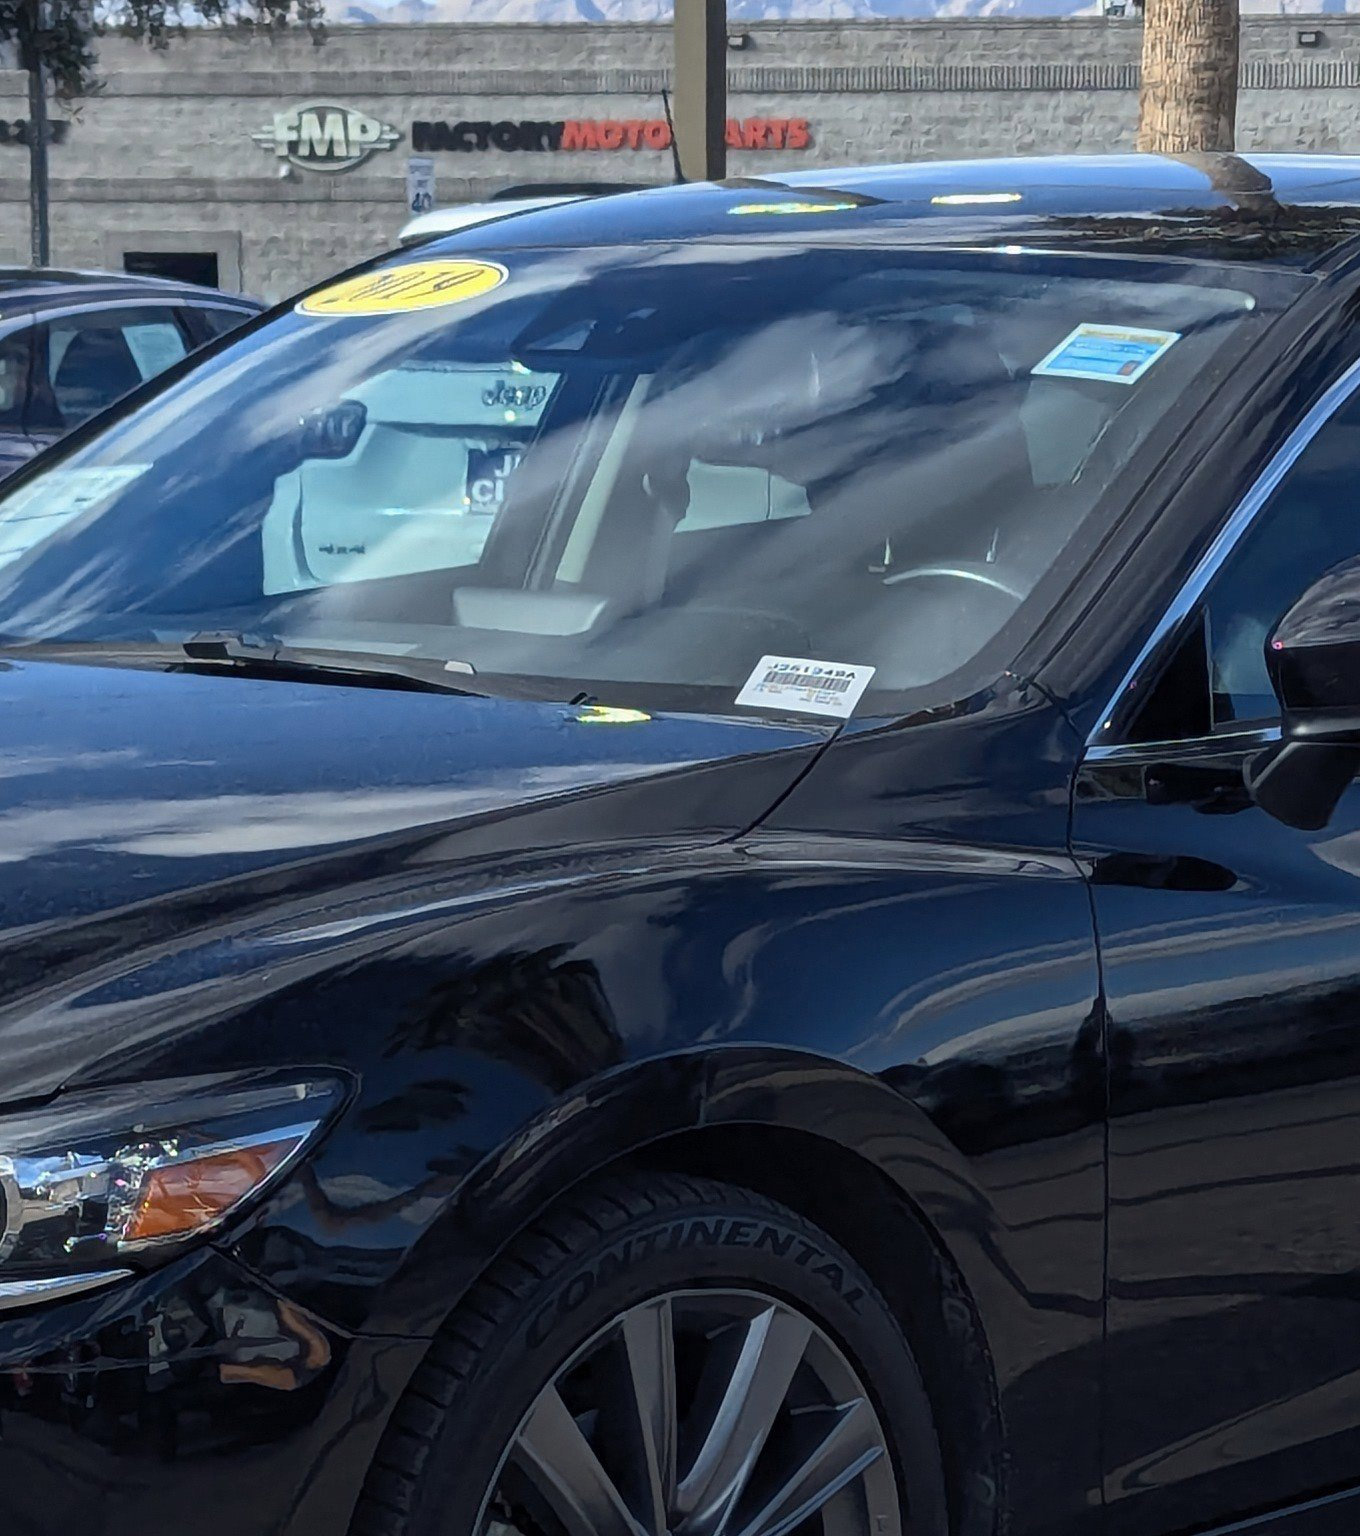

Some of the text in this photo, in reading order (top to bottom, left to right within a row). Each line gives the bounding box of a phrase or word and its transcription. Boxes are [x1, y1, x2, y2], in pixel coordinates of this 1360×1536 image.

[273, 113, 381, 156] FMP
[561, 119, 674, 150] MOTO
[725, 117, 812, 149] ARTS
[526, 1218, 866, 1349] CONTINENTAL
